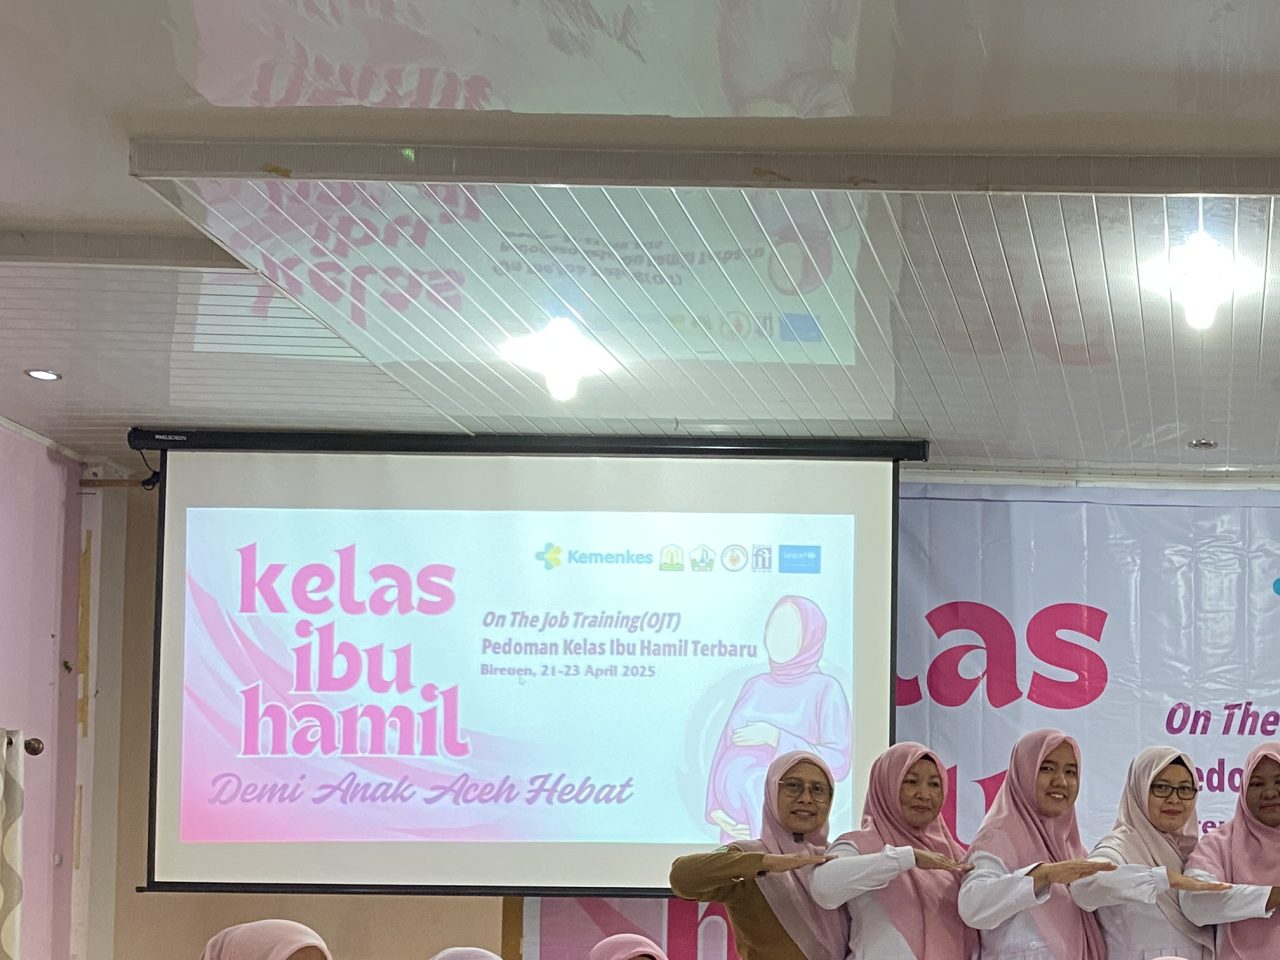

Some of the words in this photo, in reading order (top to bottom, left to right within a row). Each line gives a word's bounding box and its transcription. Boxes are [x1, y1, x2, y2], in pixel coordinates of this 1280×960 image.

[567, 549, 654, 565] Kemenkes
[236, 543, 457, 617] kelas
[482, 611, 506, 628] On
[511, 611, 540, 628] The
[539, 611, 570, 632] Job
[572, 611, 682, 633] Training(OJT)
[291, 619, 414, 694] ibu
[482, 638, 559, 656] Pedoman
[563, 638, 606, 656] Kelas
[610, 638, 637, 656] Ibu
[640, 639, 688, 657] Hamil
[691, 640, 758, 658] Terbaru
[480, 663, 536, 677] Bireuen,
[541, 665, 580, 677] 21-23
[584, 665, 618, 679] April
[622, 665, 656, 677] 2025
[239, 683, 471, 757] hamil
[1165, 702, 1211, 735] On
[1220, 701, 1280, 736] The
[208, 772, 305, 805] Demi
[312, 772, 416, 805] Anak
[424, 773, 520, 806] Aceh
[525, 773, 635, 806] Hebat
